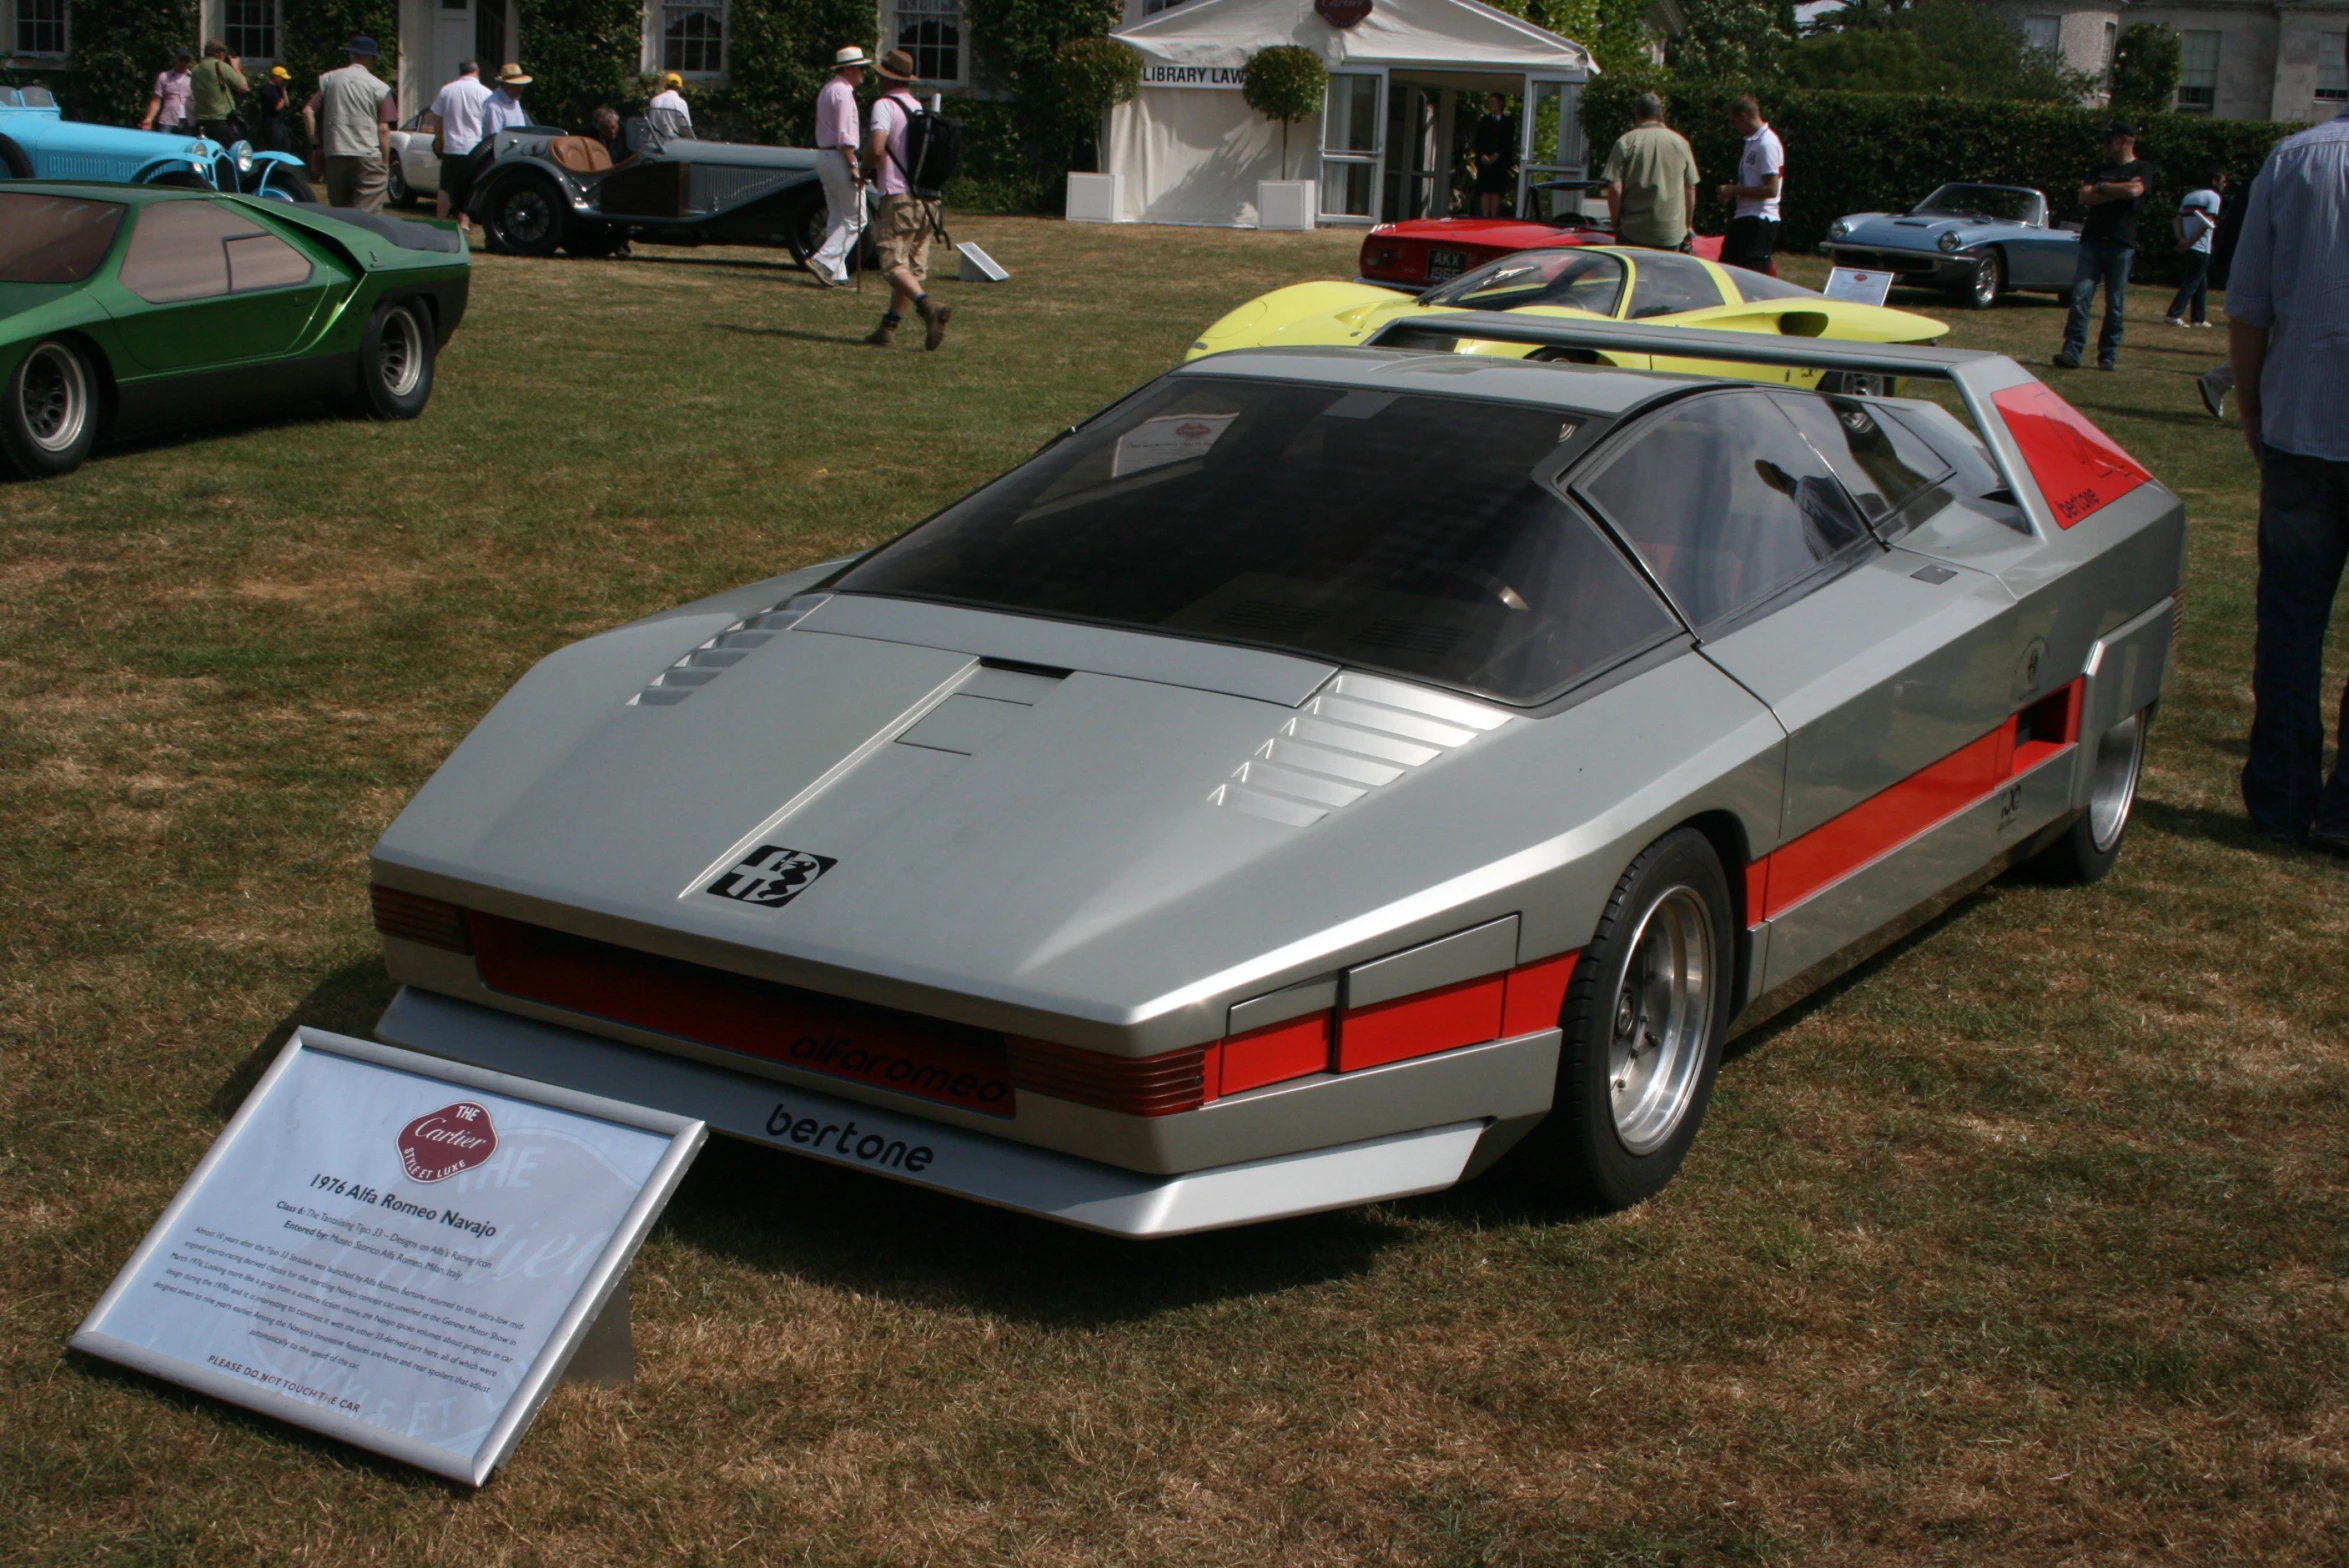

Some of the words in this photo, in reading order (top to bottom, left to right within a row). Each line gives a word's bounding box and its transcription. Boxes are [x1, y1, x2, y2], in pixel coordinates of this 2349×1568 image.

[1143, 66, 1207, 82] LIBRARY
[1434, 252, 1460, 267] AKX
[2054, 488, 2099, 518] bertone
[790, 1036, 1007, 1103] alfaromeo
[415, 1117, 486, 1149] Cartier
[456, 1105, 480, 1121] THE
[766, 1104, 933, 1172] bertone
[404, 1147, 420, 1175] STYLE
[418, 1169, 433, 1179] ET
[437, 1160, 466, 1178] LUXE
[310, 1173, 347, 1194] 1976
[344, 1184, 378, 1204] Alfa
[380, 1193, 437, 1220] Romeo
[439, 1209, 496, 1238] Navajo
[277, 1200, 297, 1213] Class
[297, 1206, 306, 1215] 6:
[307, 1208, 320, 1219] The
[321, 1212, 355, 1230] Tantalising
[356, 1222, 371, 1234] Tipo
[372, 1227, 384, 1237] 33
[390, 1232, 418, 1248] Designs
[418, 1244, 430, 1252] on
[451, 1250, 476, 1267] Racing
[476, 1257, 492, 1269] Icon
[284, 1220, 317, 1236] Entered
[316, 1229, 329, 1240] by:
[330, 1233, 353, 1247] Museo
[354, 1240, 381, 1255] Storico
[380, 1249, 395, 1260] Alfa
[446, 1268, 463, 1281] Italy
[207, 1354, 243, 1373] PLEASE
[243, 1366, 259, 1378] DO
[258, 1372, 283, 1386] NOT
[282, 1379, 318, 1398] TOUCH
[317, 1391, 339, 1405] THE
[339, 1399, 360, 1413] CAR
